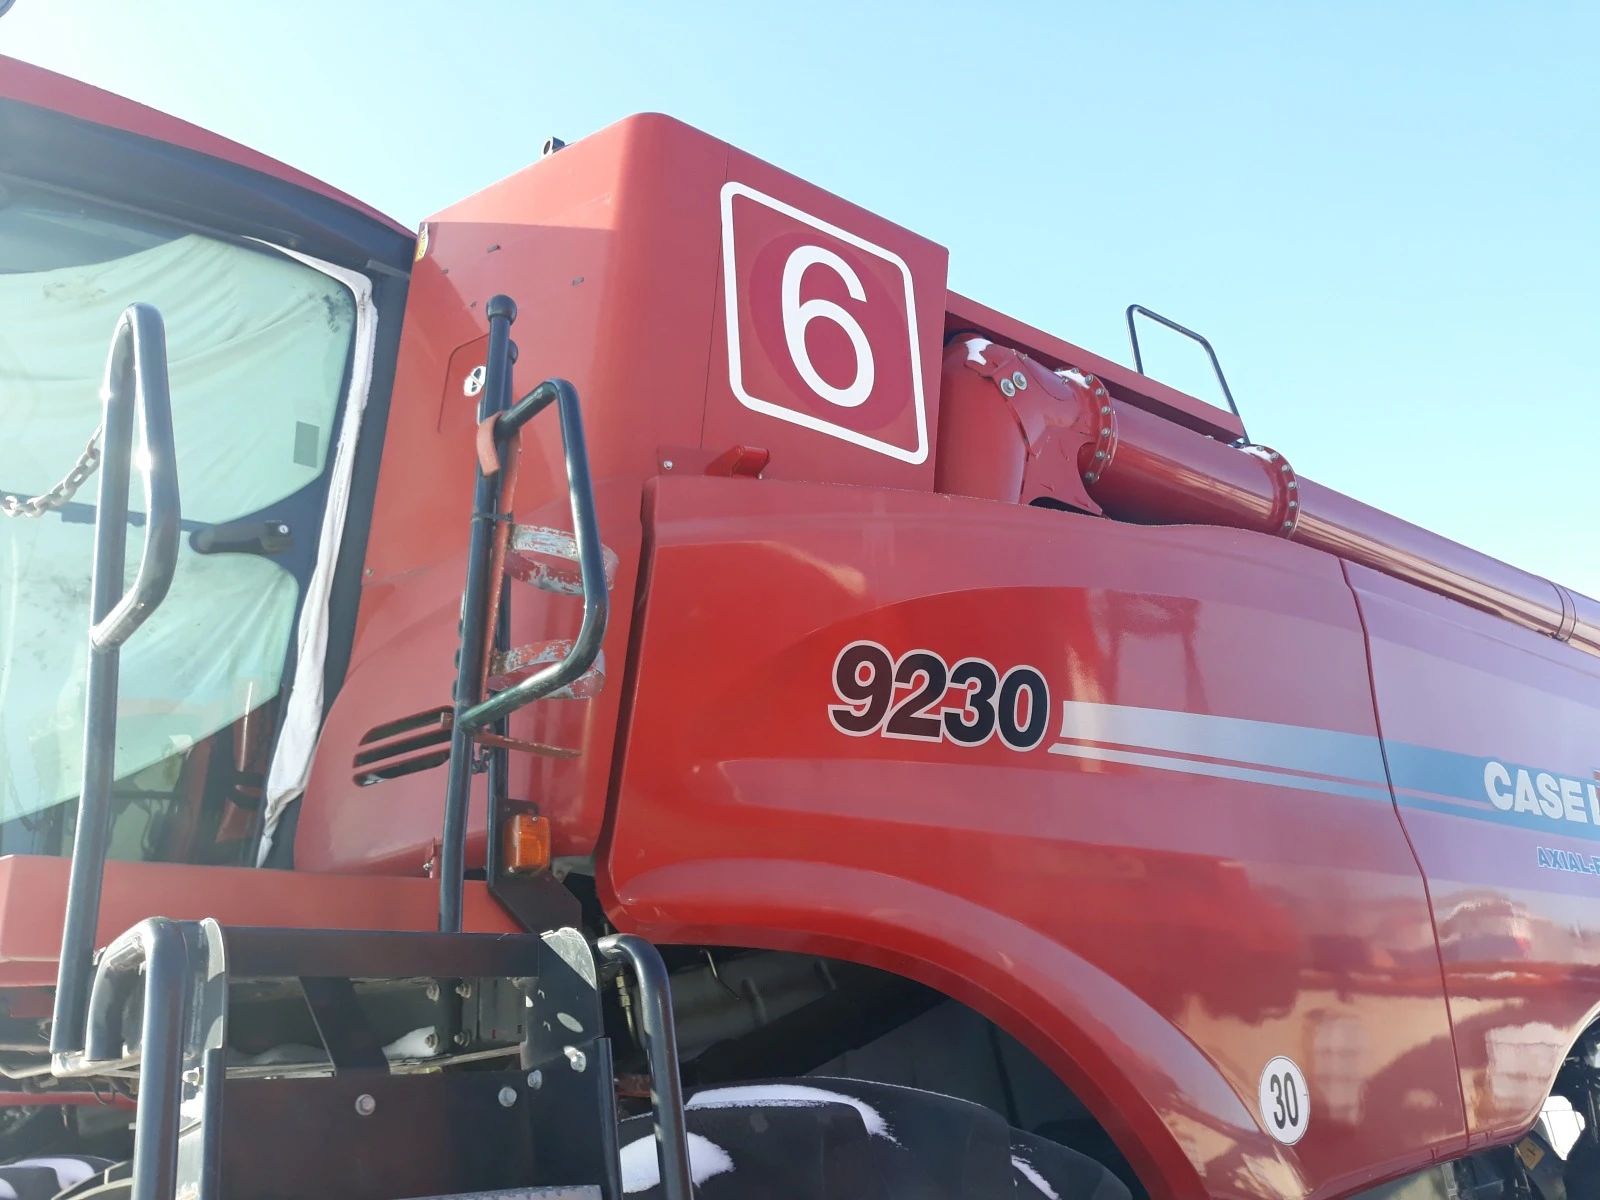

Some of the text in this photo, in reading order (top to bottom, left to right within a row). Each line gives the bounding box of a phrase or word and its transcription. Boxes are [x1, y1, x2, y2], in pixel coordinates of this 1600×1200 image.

[782, 245, 875, 408] 6
[828, 640, 1050, 752] 9230
[1484, 761, 1588, 824] CASE
[1270, 1072, 1299, 1130] 30
